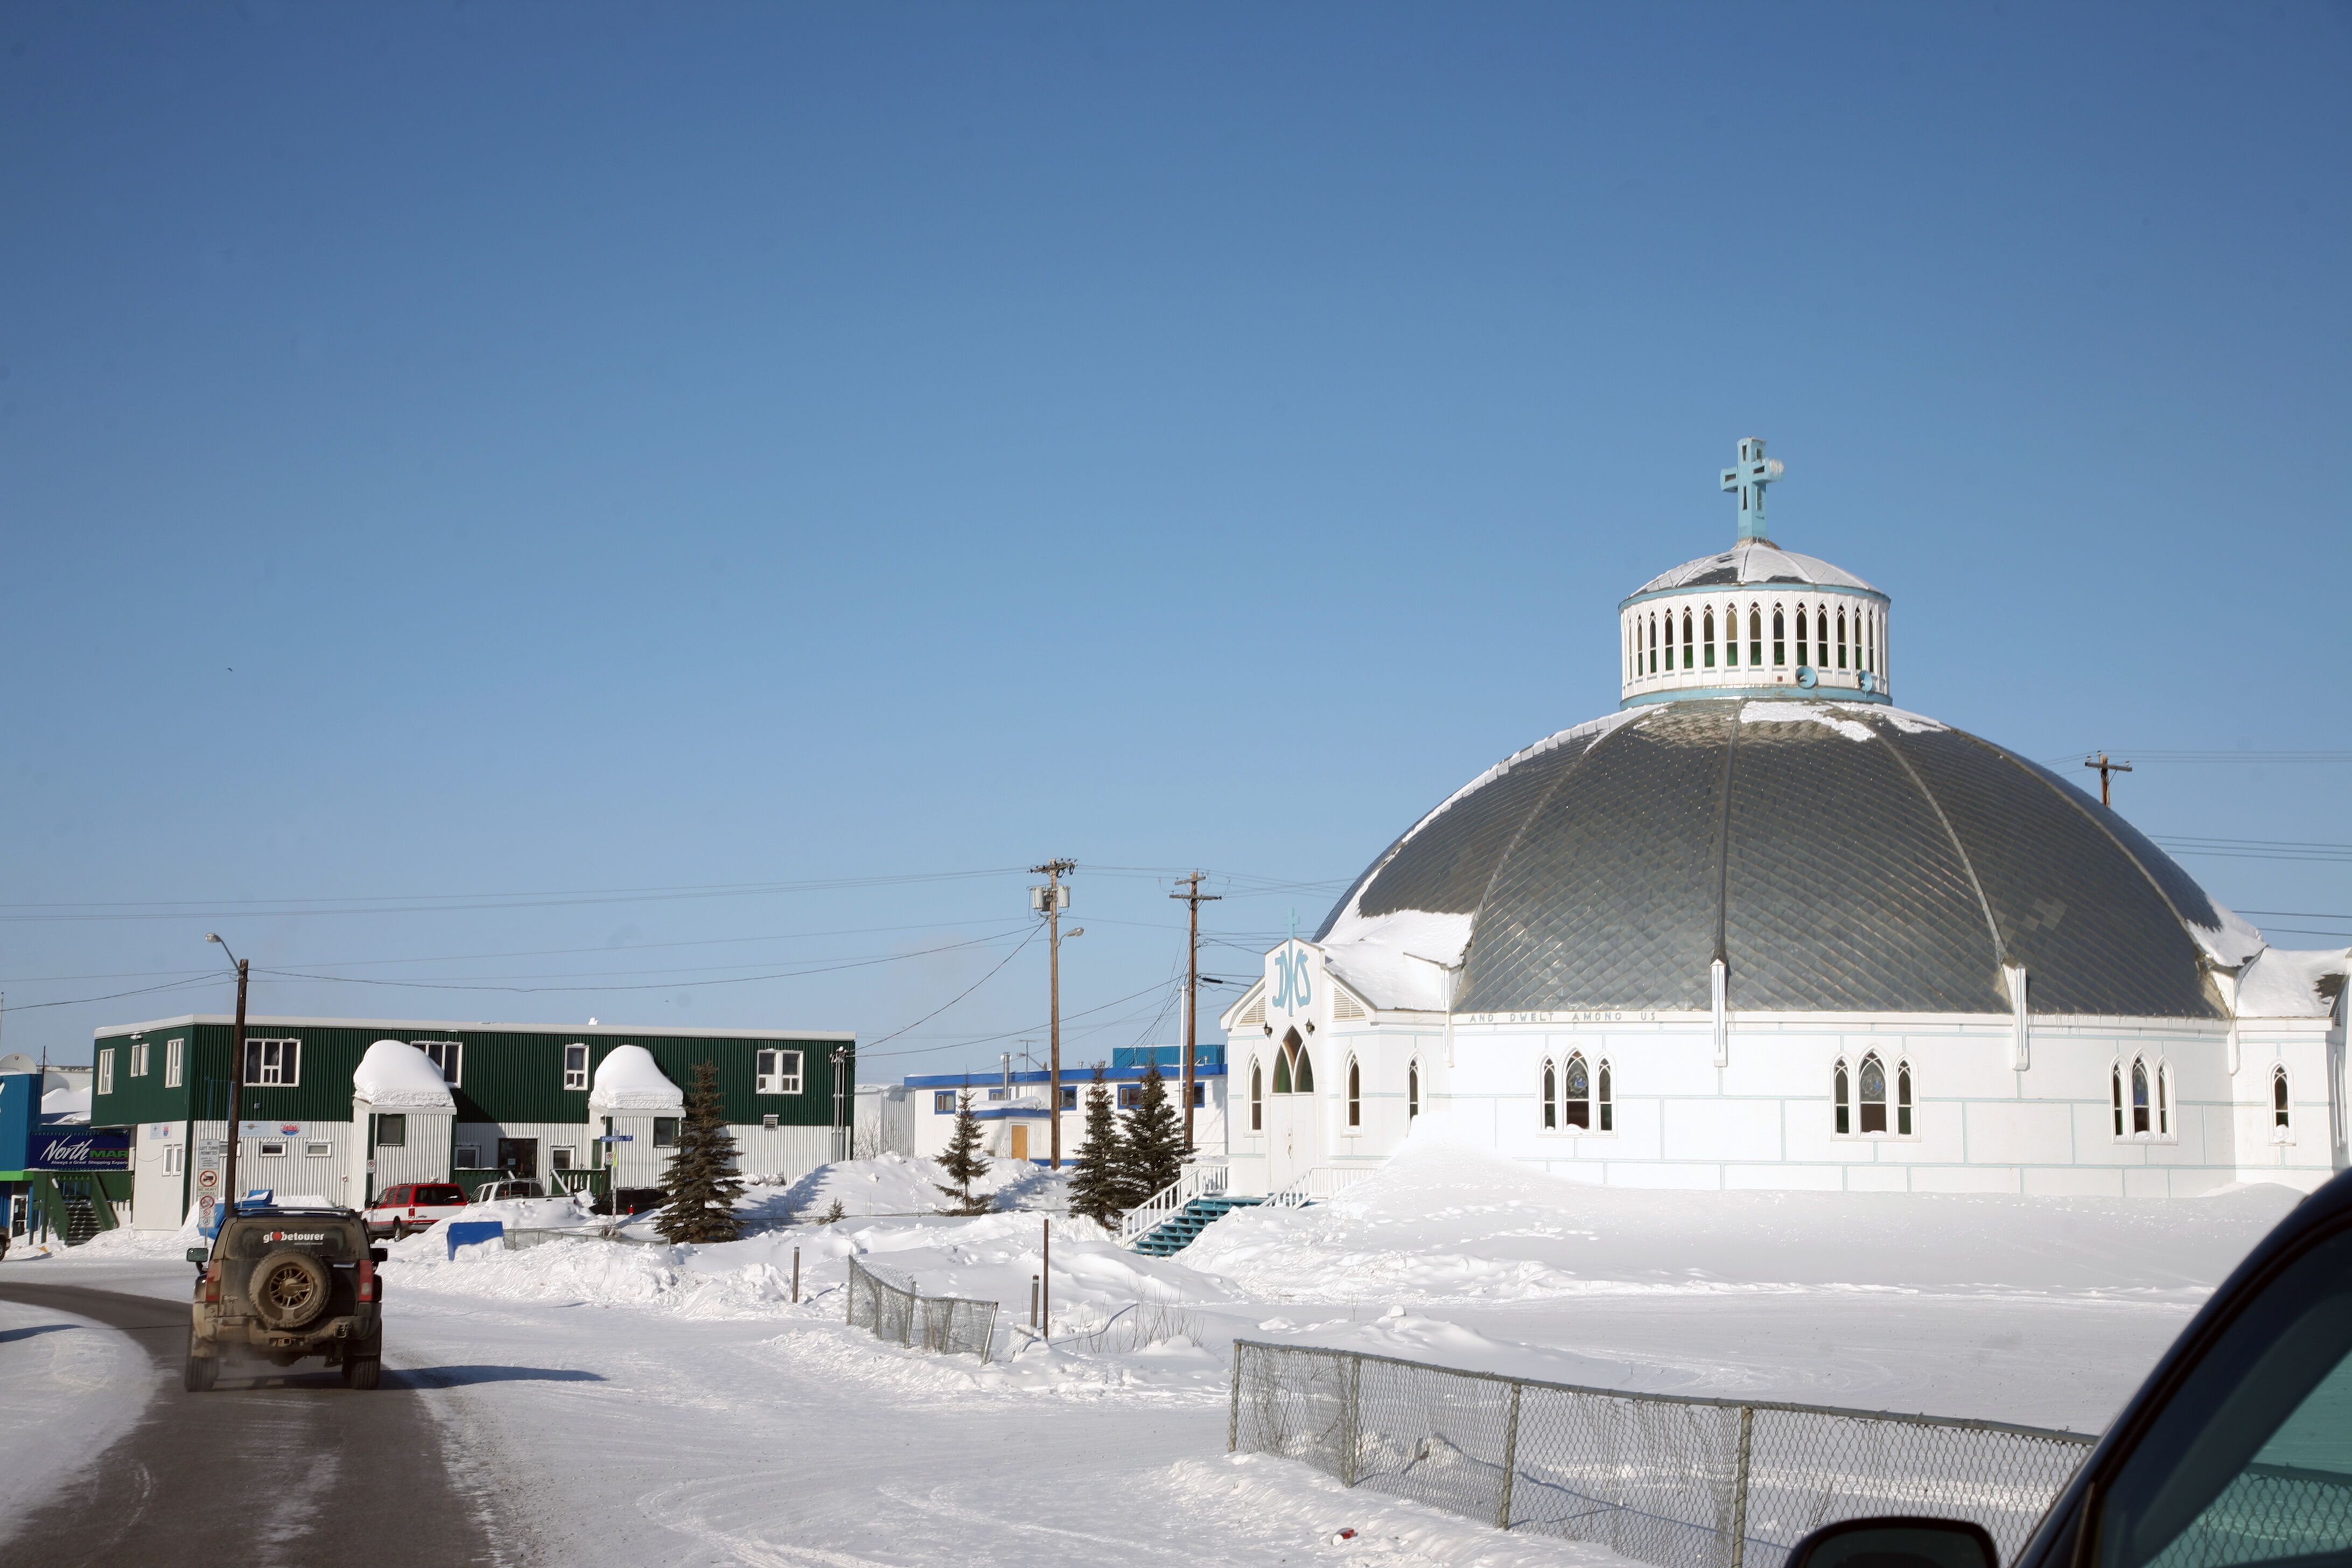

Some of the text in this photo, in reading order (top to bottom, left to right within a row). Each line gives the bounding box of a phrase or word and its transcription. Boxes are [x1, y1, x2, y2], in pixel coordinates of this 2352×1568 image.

[1469, 1012, 1656, 1023] AND DWELT AMONG US
[39, 1135, 94, 1161] North
[263, 1231, 325, 1243] globetourer
